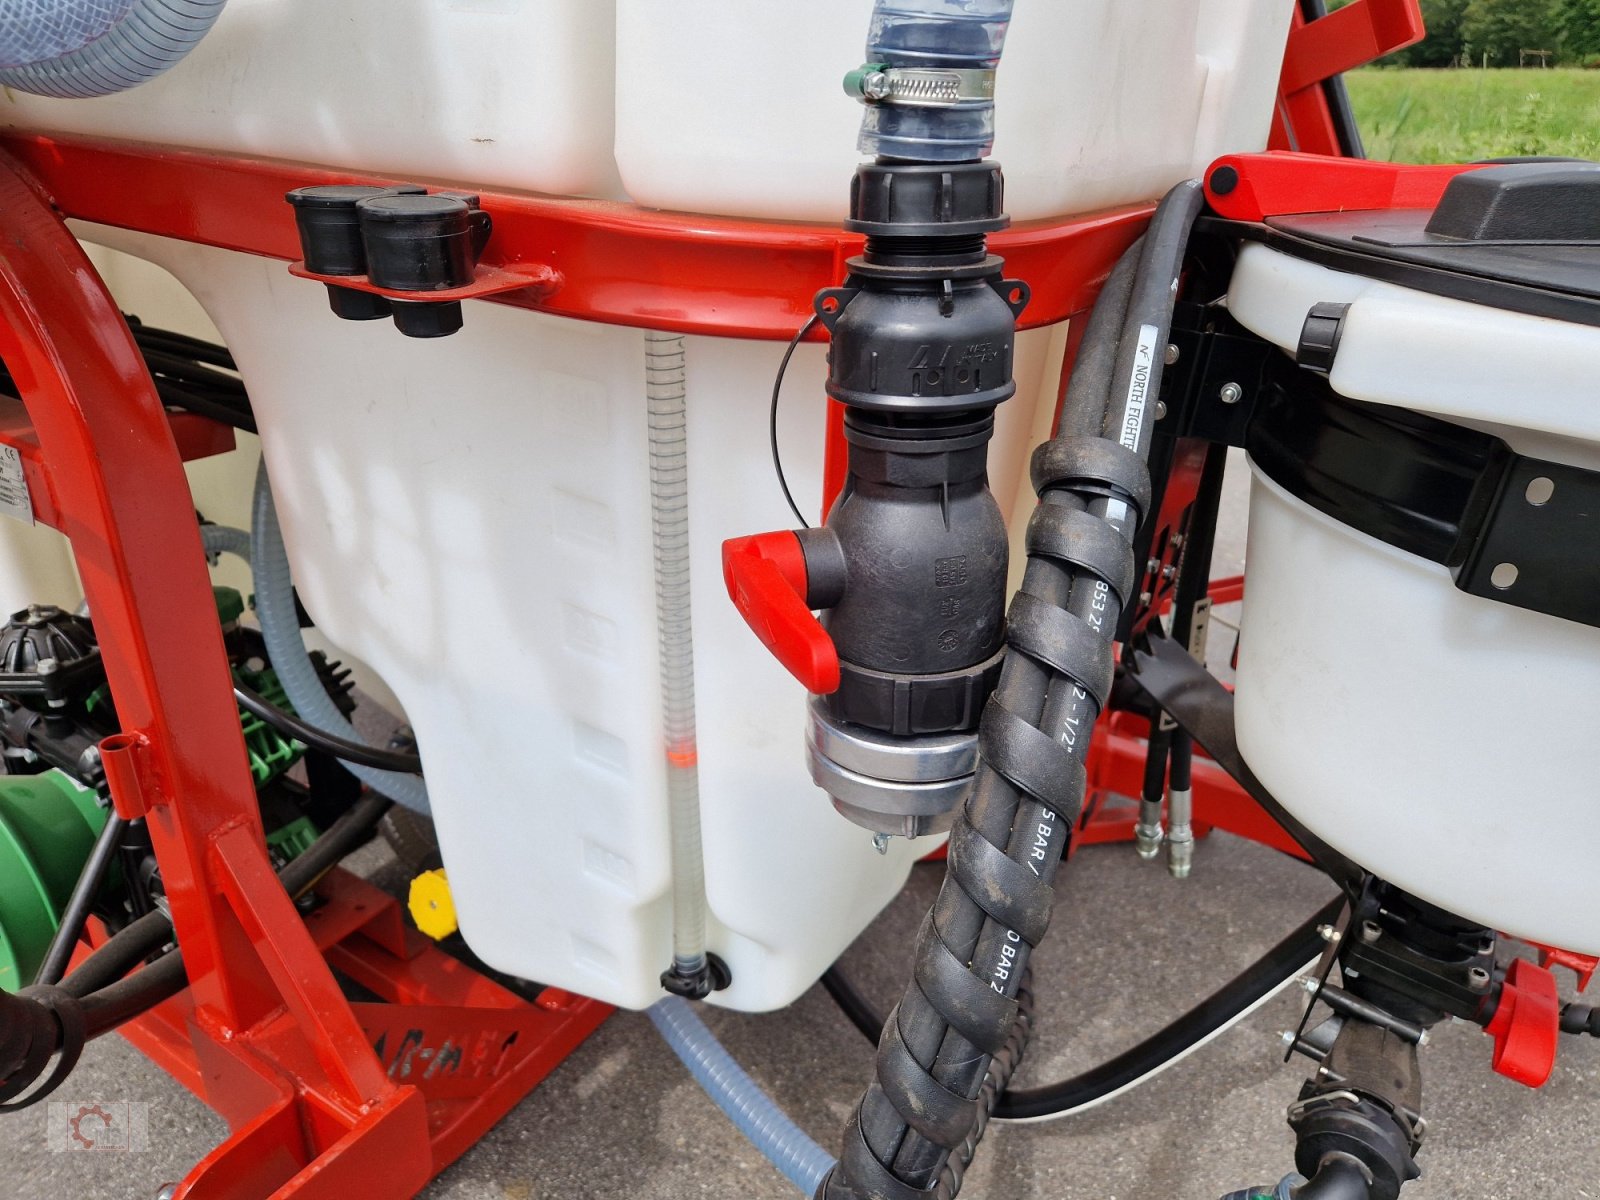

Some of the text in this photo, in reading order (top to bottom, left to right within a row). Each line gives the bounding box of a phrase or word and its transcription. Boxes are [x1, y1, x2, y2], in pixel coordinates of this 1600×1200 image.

[1131, 364, 1148, 404] NORTH
[1091, 580, 1109, 612] 853
[1072, 682, 1086, 700] 2
[1030, 822, 1051, 861] BAR
[995, 943, 1016, 980] BAR
